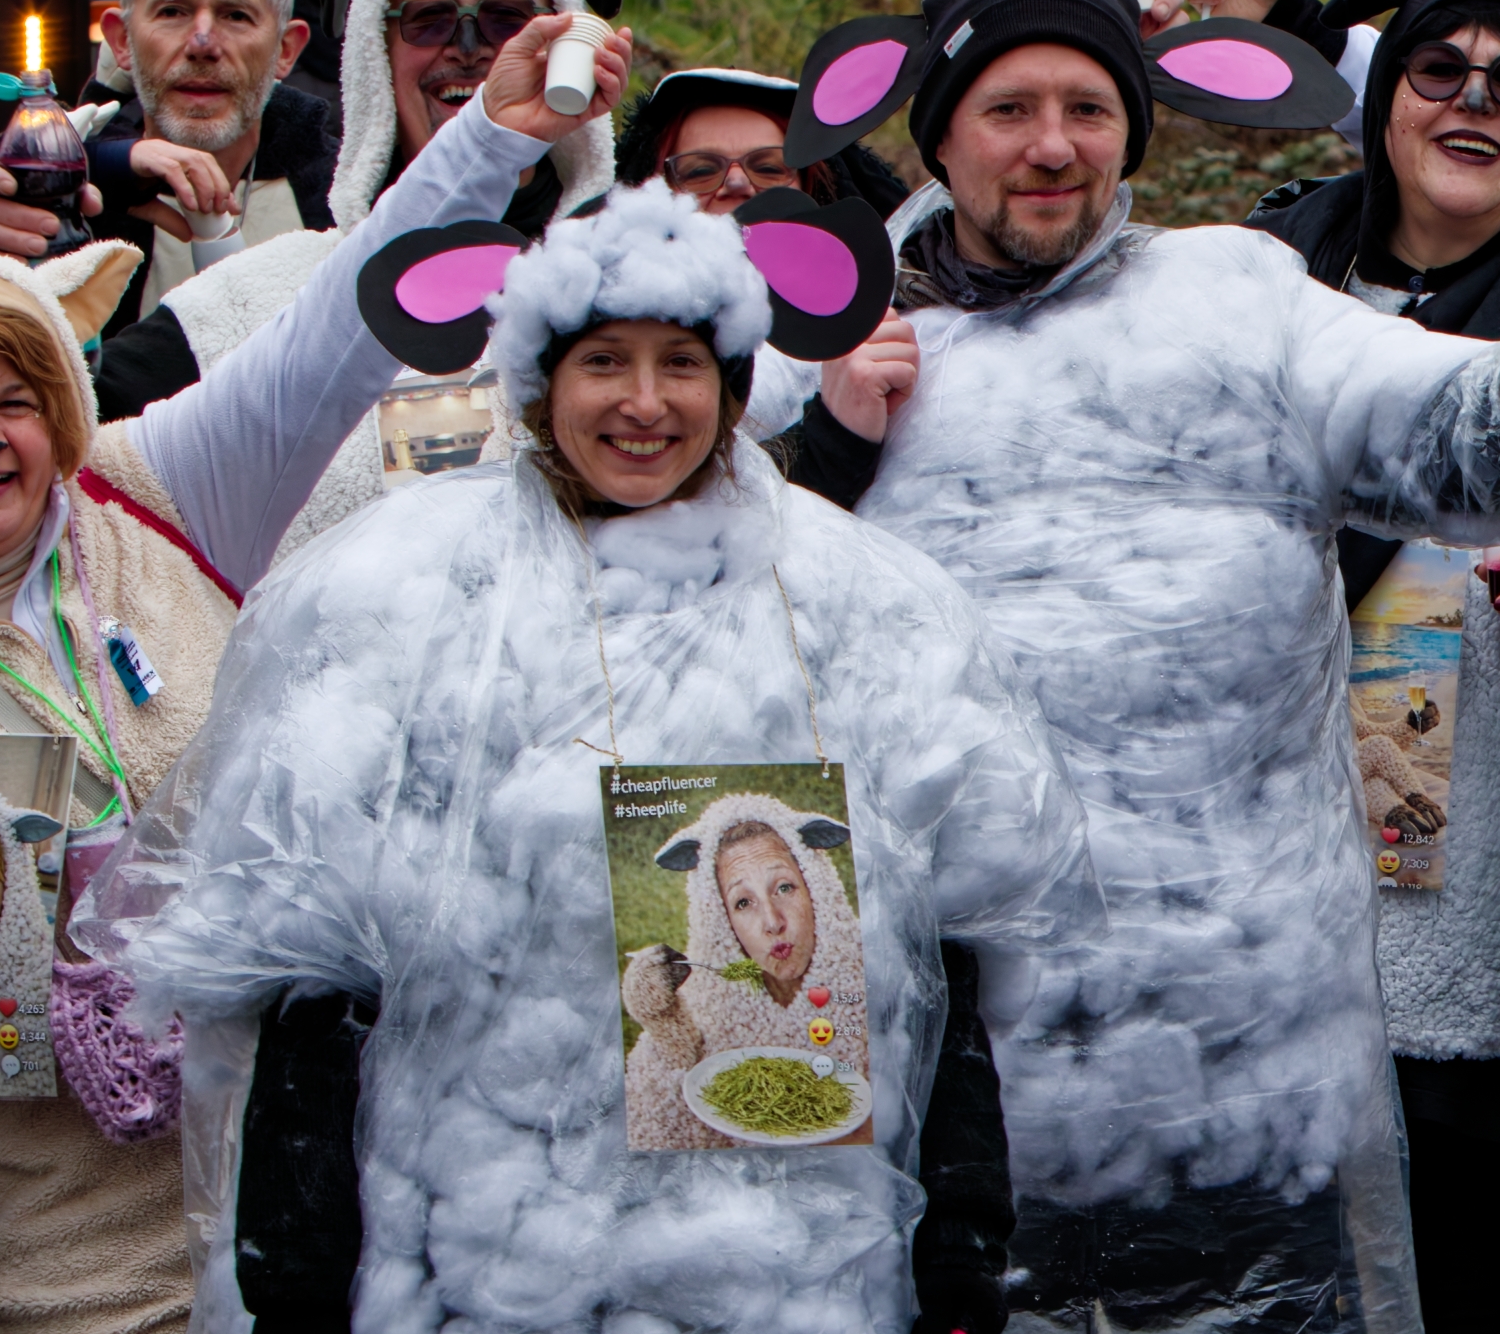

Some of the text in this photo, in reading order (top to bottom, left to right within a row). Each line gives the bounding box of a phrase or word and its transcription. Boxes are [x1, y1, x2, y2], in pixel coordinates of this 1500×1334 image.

[610, 776, 718, 795] #cheapfluencer
[615, 799, 687, 819] #sheeplife
[1402, 833, 1435, 845] 12,842
[21, 1060, 40, 1071] 701
